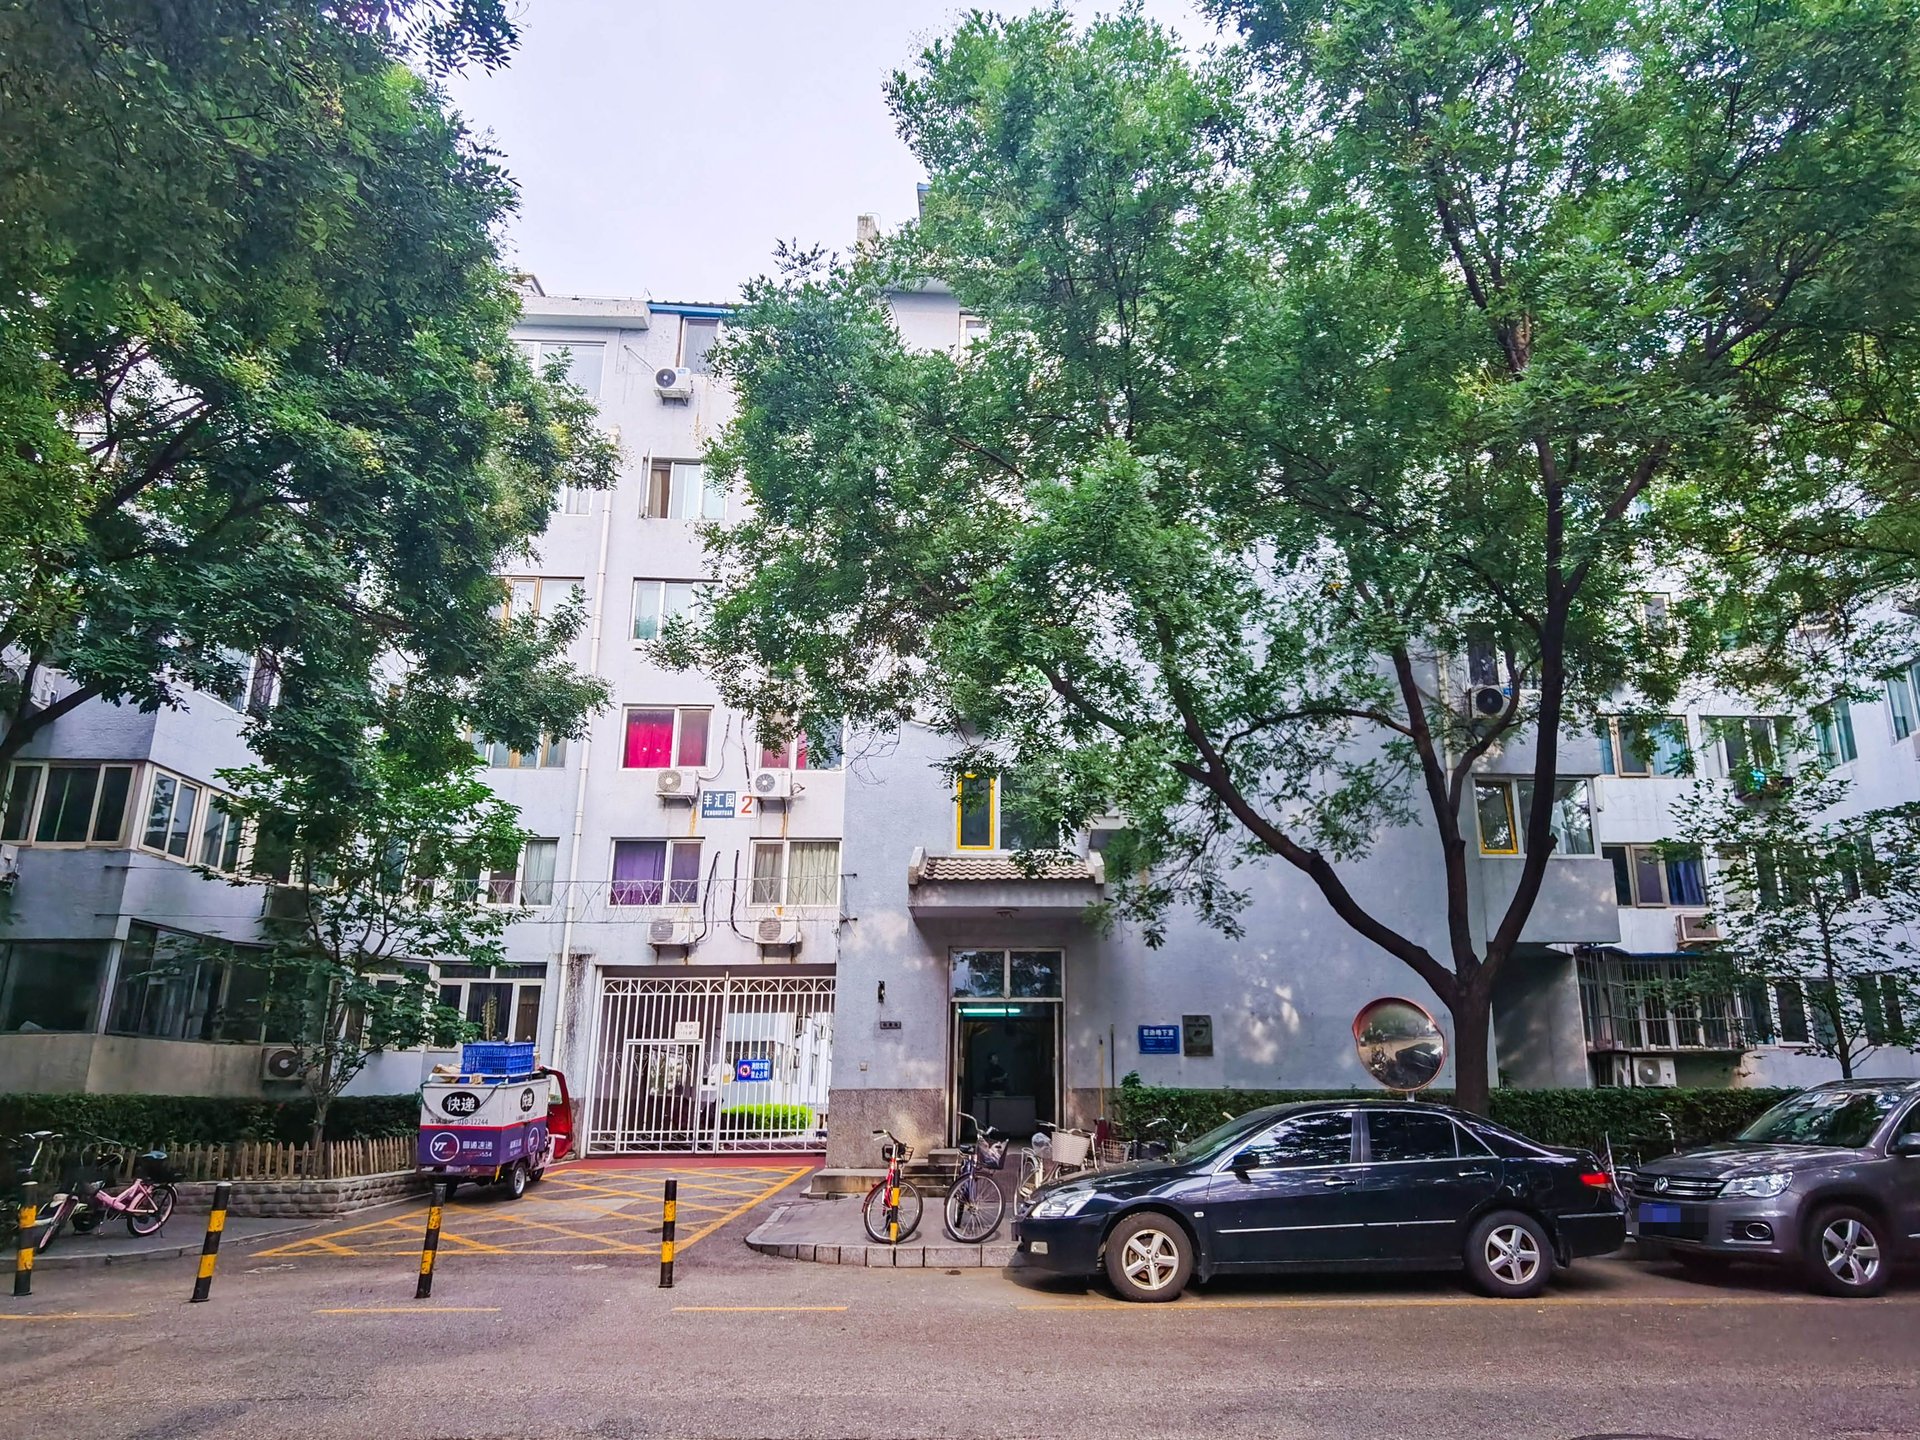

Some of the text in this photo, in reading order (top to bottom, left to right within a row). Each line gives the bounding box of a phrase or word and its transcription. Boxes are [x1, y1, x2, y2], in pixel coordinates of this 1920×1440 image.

[703, 794, 753, 814] 丰汇园 2
[446, 1096, 475, 1112] 快递
